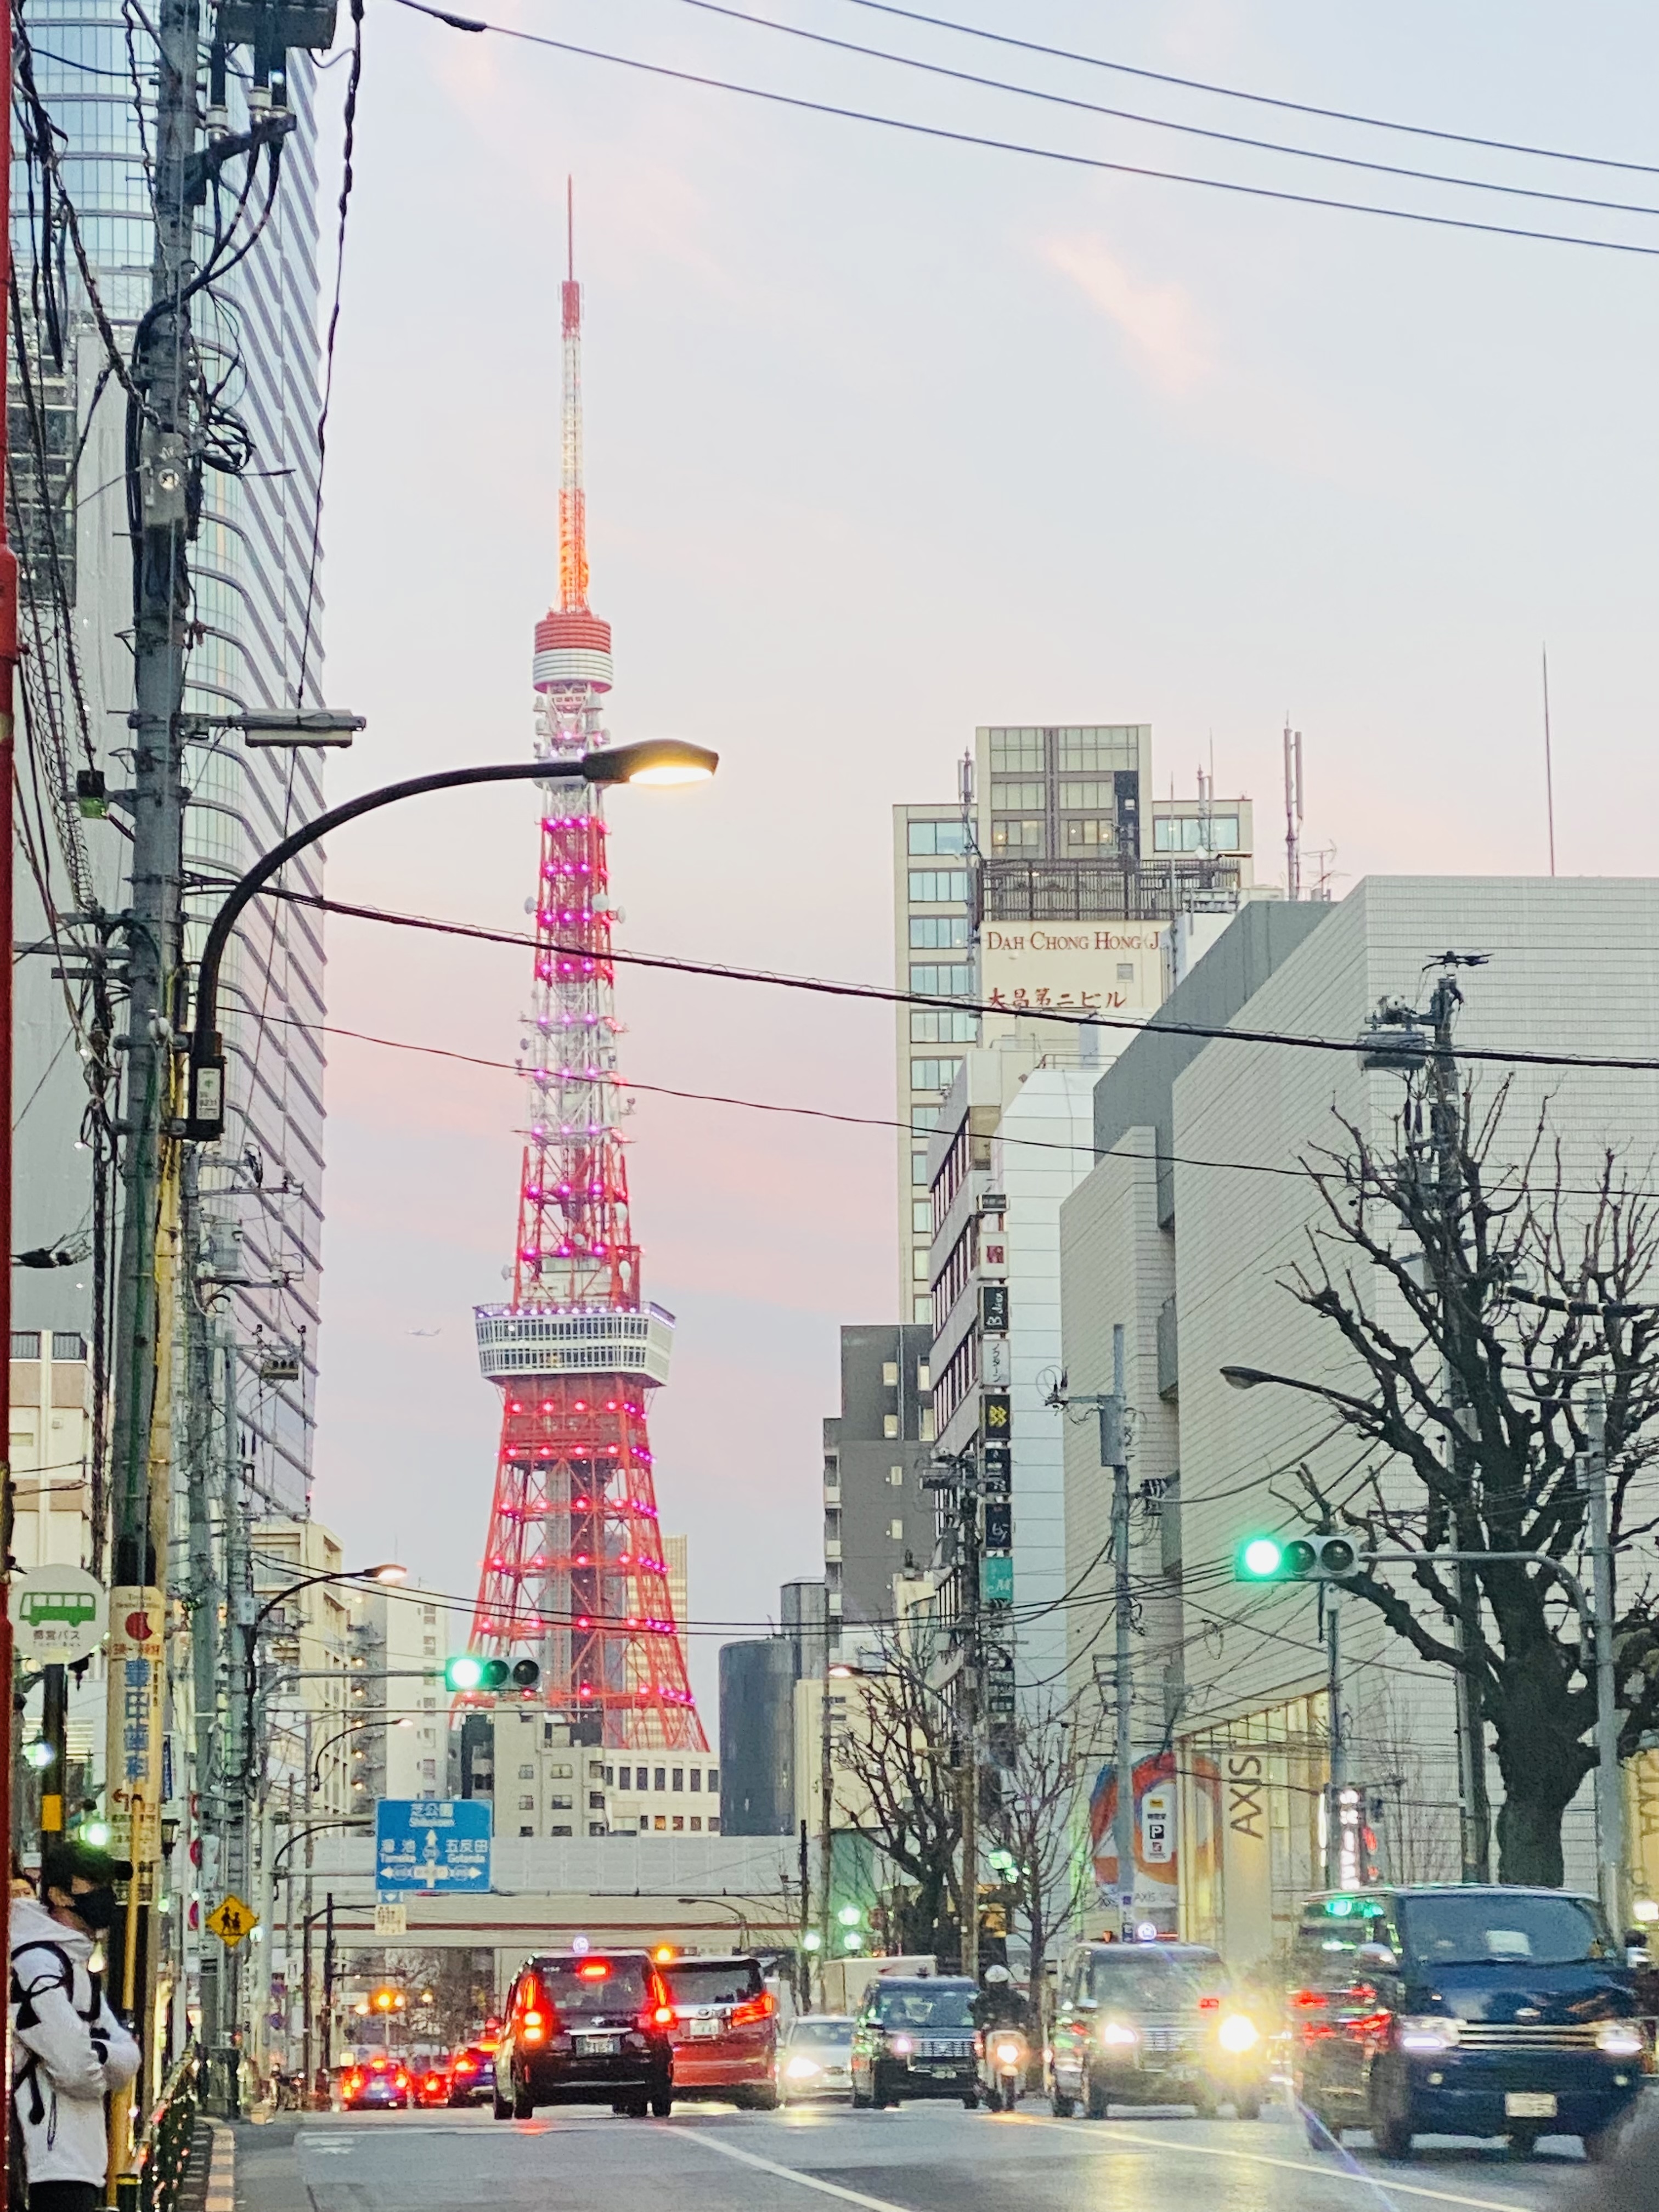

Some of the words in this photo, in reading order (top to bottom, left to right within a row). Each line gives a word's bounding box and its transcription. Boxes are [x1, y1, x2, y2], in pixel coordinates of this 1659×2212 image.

[987, 931, 1024, 950] DAH
[1030, 931, 1089, 950] CHONG
[1094, 931, 1142, 950] HONG
[989, 987, 1127, 1009] 大昌第二ビル
[33, 1629, 80, 1640] 都営バス
[1228, 1755, 1264, 1841] AXIS
[1150, 1825, 1164, 1839] P
[445, 1839, 488, 1853] 五反田
